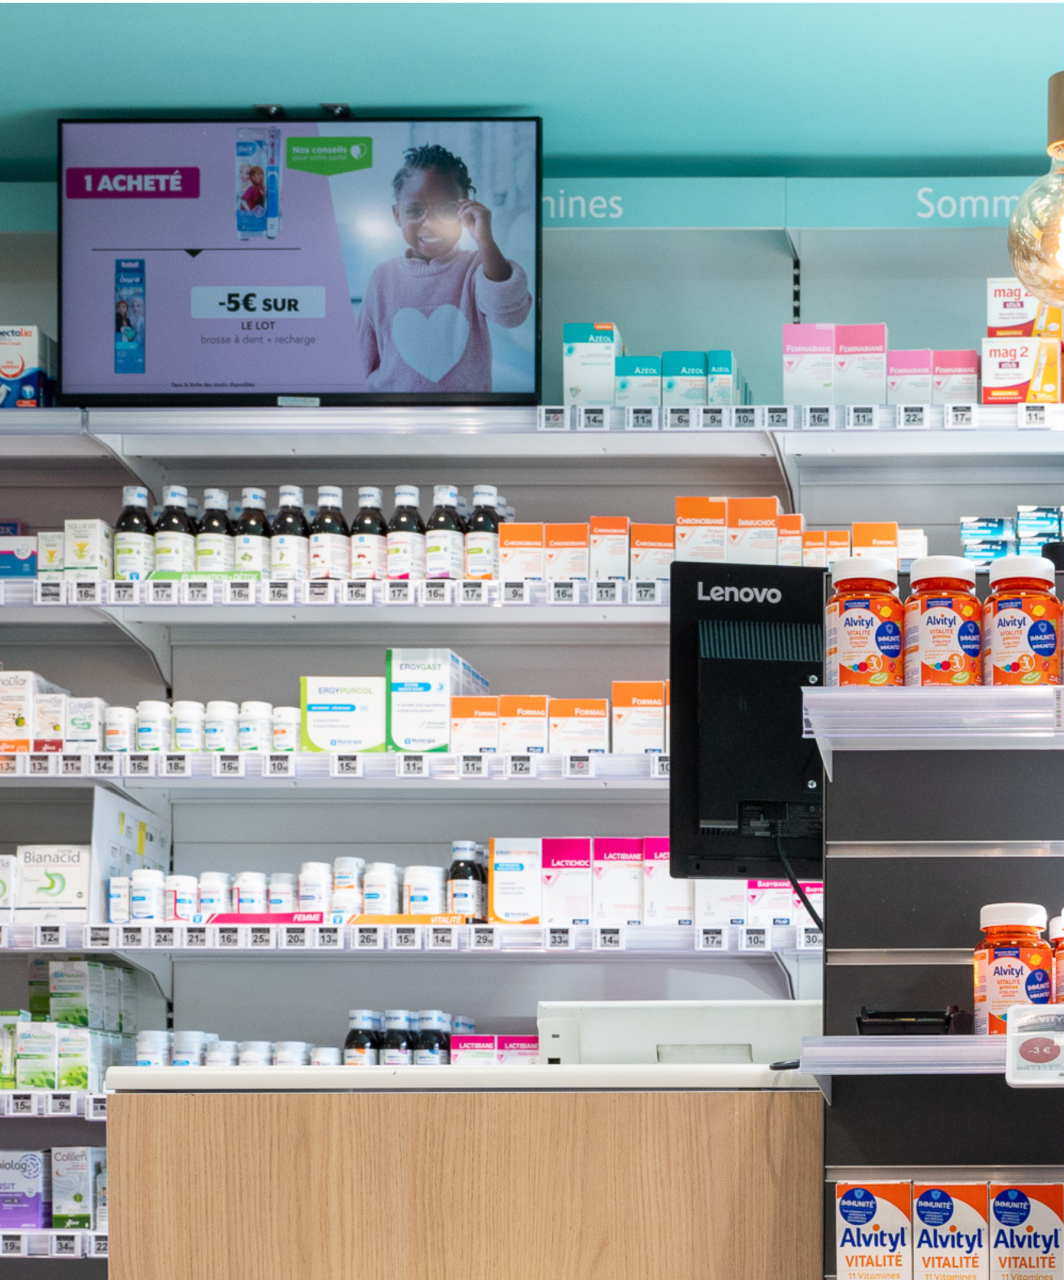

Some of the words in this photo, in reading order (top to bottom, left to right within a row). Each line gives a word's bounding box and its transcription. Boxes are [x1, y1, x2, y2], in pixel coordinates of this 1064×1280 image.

[291, 145, 310, 155] Nos
[311, 145, 347, 155] conseils
[84, 174, 93, 192] 1
[97, 169, 182, 192] ACHETÉ
[218, 292, 257, 313] -5€
[262, 298, 299, 313] SUR
[241, 321, 252, 331] LE
[256, 321, 275, 331] LOT
[200, 334, 231, 345] brosse
[234, 334, 240, 345] à
[242, 334, 264, 345] dent
[275, 334, 316, 347] recharge
[786, 344, 833, 353] FEMINABIANE
[838, 344, 884, 353] FEMINABIANE
[989, 348, 1018, 362] mag
[1019, 347, 1029, 358] 2
[889, 366, 930, 374] FEMINABIANE
[935, 366, 976, 374] FEMINABIANE
[676, 516, 725, 525] CHRONOBIANE
[504, 539, 542, 547] CHRONOBIANE
[635, 540, 674, 548] CHRONOBIANE
[697, 580, 782, 604] Lenovo
[843, 614, 874, 629] Alvityl
[926, 613, 957, 628] Alvityl
[997, 614, 1027, 629] Alvityl
[399, 663, 442, 671] ERGYGAST
[318, 687, 373, 695] ERGYPURCOL
[632, 697, 663, 706] FORMAG
[517, 707, 545, 716] FORMAG
[574, 707, 605, 716] FORMAG
[24, 851, 80, 864] Bianacid
[603, 852, 643, 860] LACTIBIANE
[551, 858, 590, 867] LACTICHOC
[292, 912, 322, 923] FEMME
[430, 914, 463, 925] VITALITÉ
[993, 964, 1025, 979] Alvityl
[1028, 1046, 1040, 1054] -3
[1042, 1046, 1051, 1054] €
[54, 1152, 88, 1162] Colilen
[840, 1199, 876, 1209] IMMUNITÉ
[917, 1200, 953, 1211] IMMUNITÉ
[993, 1200, 1030, 1211] IMMUNITÉ
[839, 1223, 907, 1253] Alvityl
[916, 1225, 984, 1255] Alvityl
[993, 1225, 1061, 1255] Alvityl
[845, 1251, 904, 1268] VITALITÉ
[921, 1252, 980, 1269] VITALITÉ
[998, 1252, 1057, 1269] VITALITÉ
[858, 1271, 901, 1280] Vitamines
[934, 1272, 978, 1280] Vitamines
